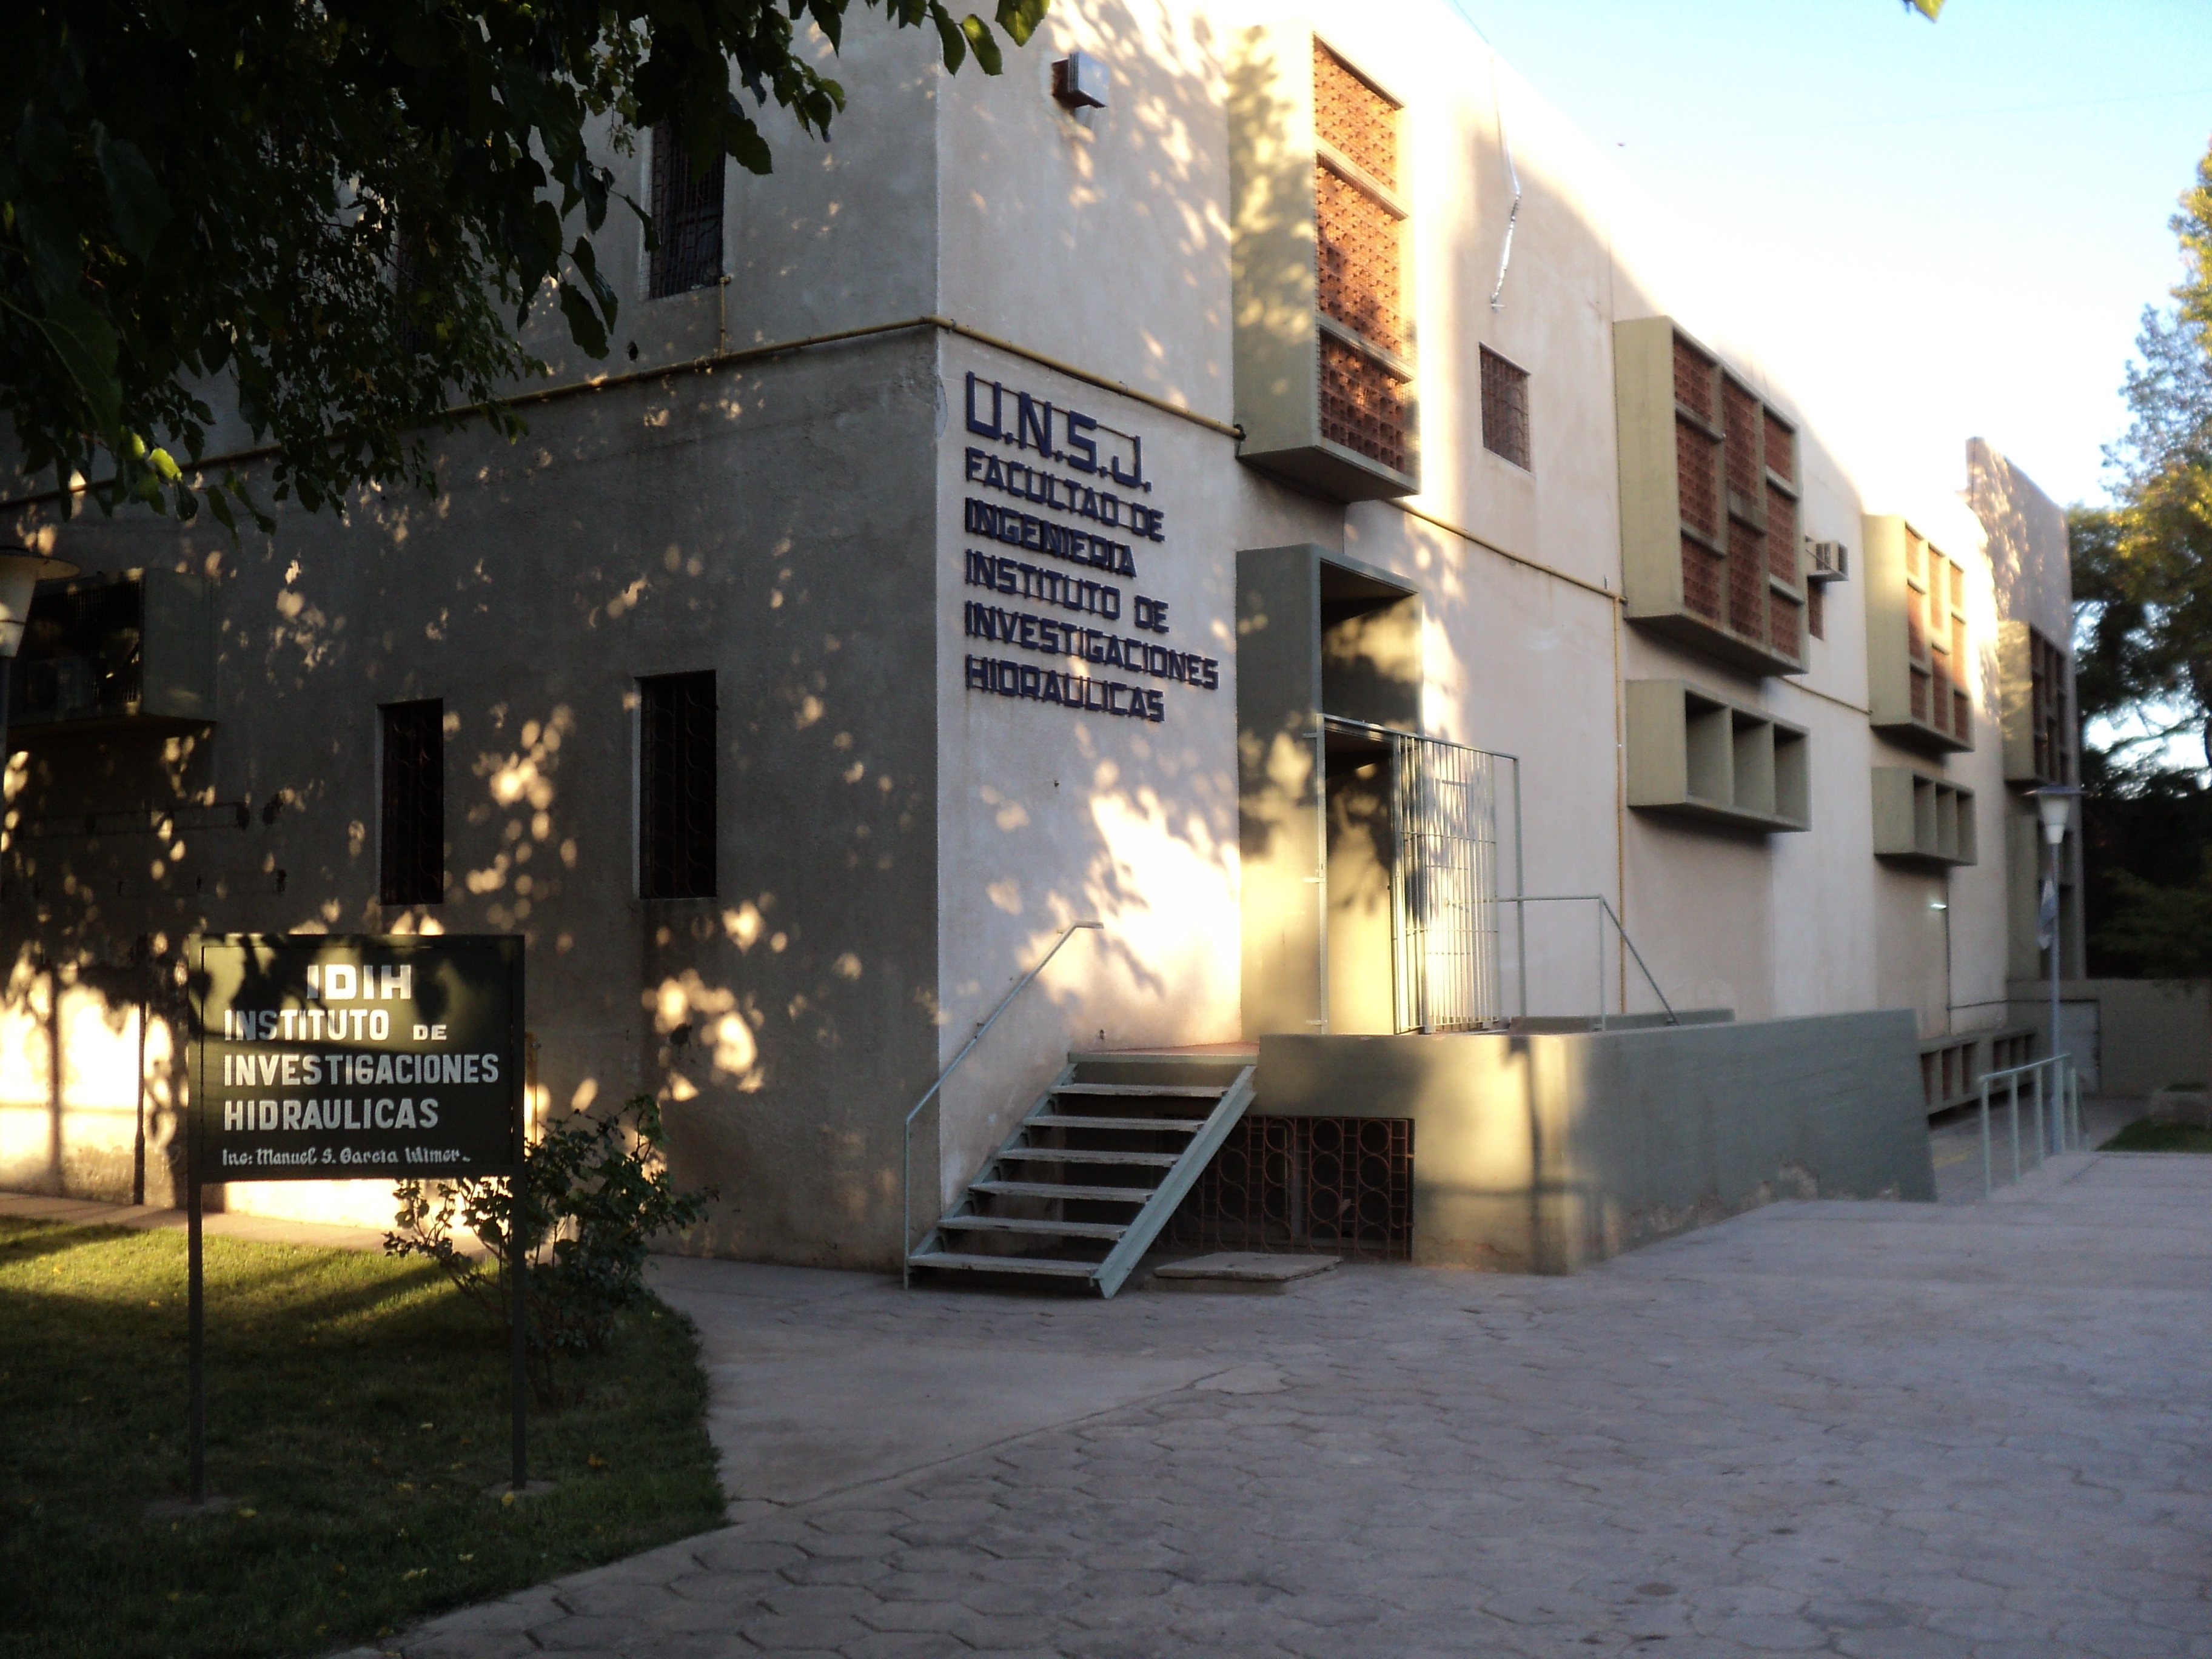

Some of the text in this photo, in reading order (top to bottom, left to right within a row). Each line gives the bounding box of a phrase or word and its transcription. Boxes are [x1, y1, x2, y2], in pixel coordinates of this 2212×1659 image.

[966, 370, 1152, 492] U.N.S.J.
[966, 447, 1165, 541] FACULTAD DE
[965, 497, 1137, 578] INGENIERIA
[965, 549, 1169, 633] INSTITUTO DE
[965, 600, 1219, 689] INVESTIGACIONES
[965, 654, 1165, 722] HIDRAULICAS
[307, 964, 411, 1000] IDIH
[224, 1009, 447, 1041] INSTITUTO DE
[224, 1054, 499, 1085] INVESTIGACIONES
[224, 1099, 438, 1130] HIDRAULICAS
[256, 1148, 316, 1165] Manuel
